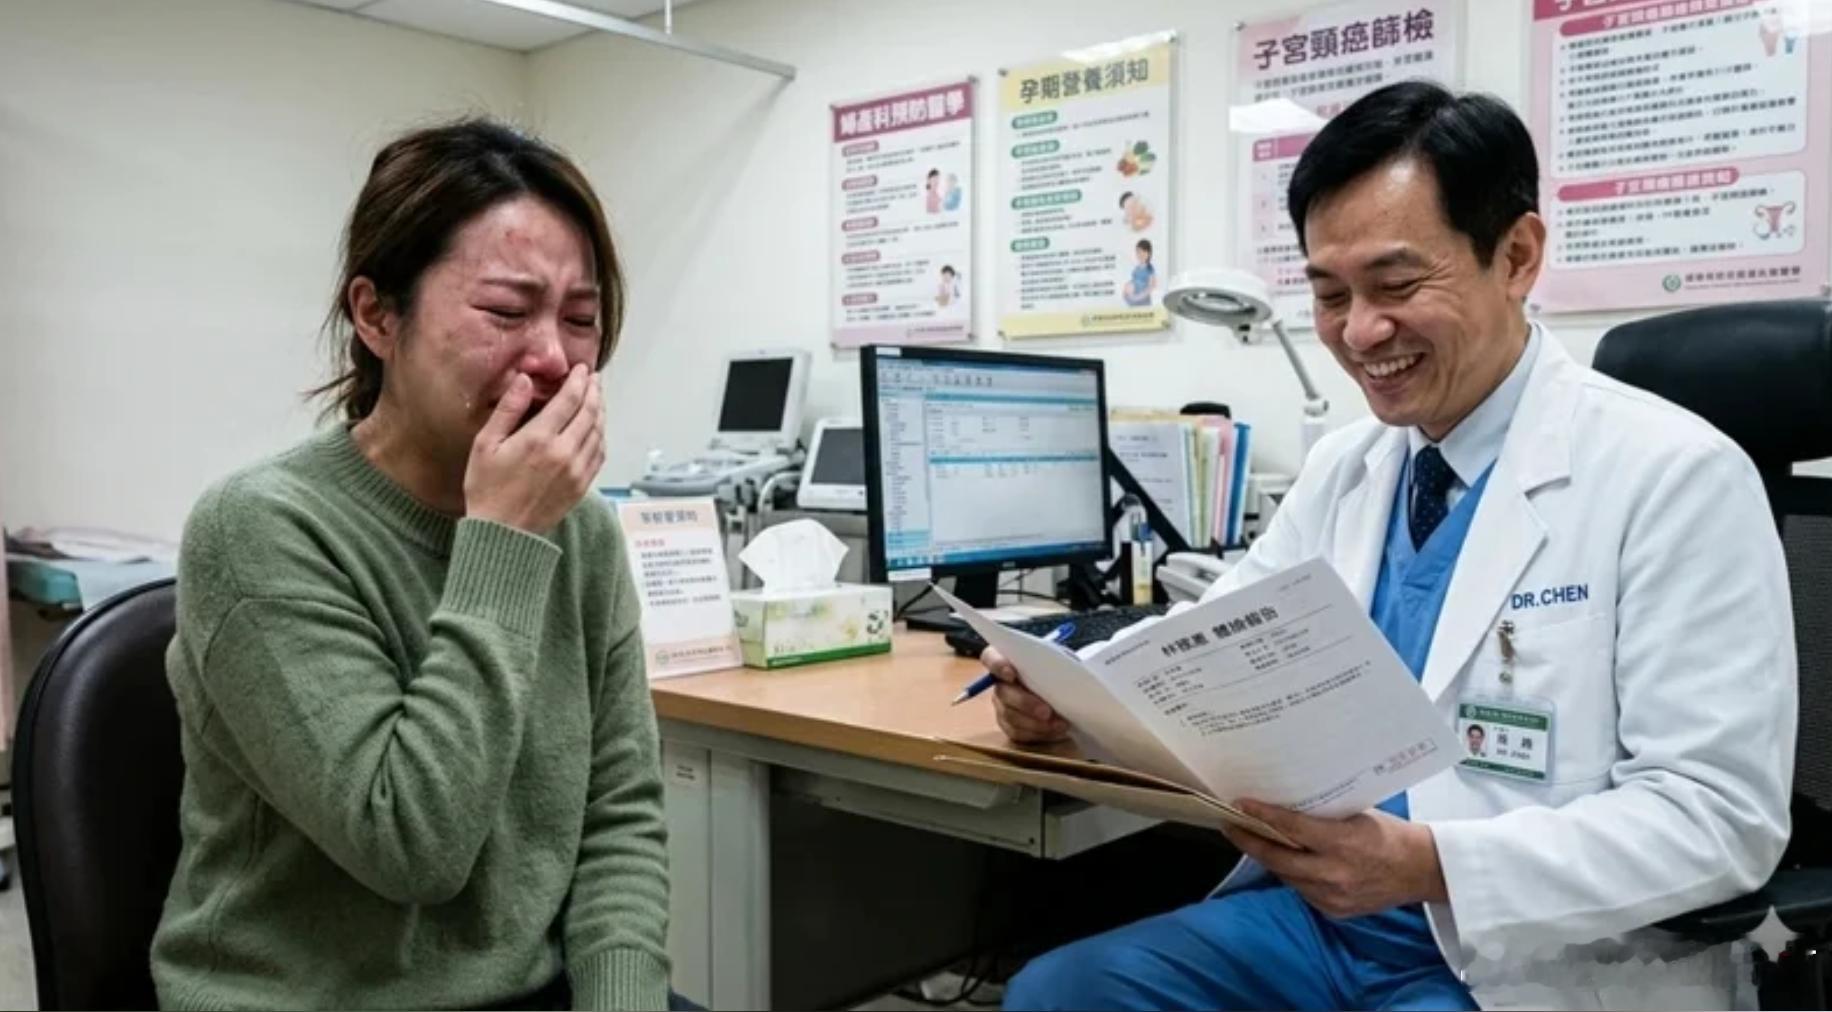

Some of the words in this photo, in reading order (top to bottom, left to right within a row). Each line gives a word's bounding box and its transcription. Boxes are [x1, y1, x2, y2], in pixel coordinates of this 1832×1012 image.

[1254, 7, 1434, 70] 子宮頸癌篩檢
[1020, 58, 1149, 104] 孕期營養須知
[1512, 584, 1589, 610] DR.CHEN
